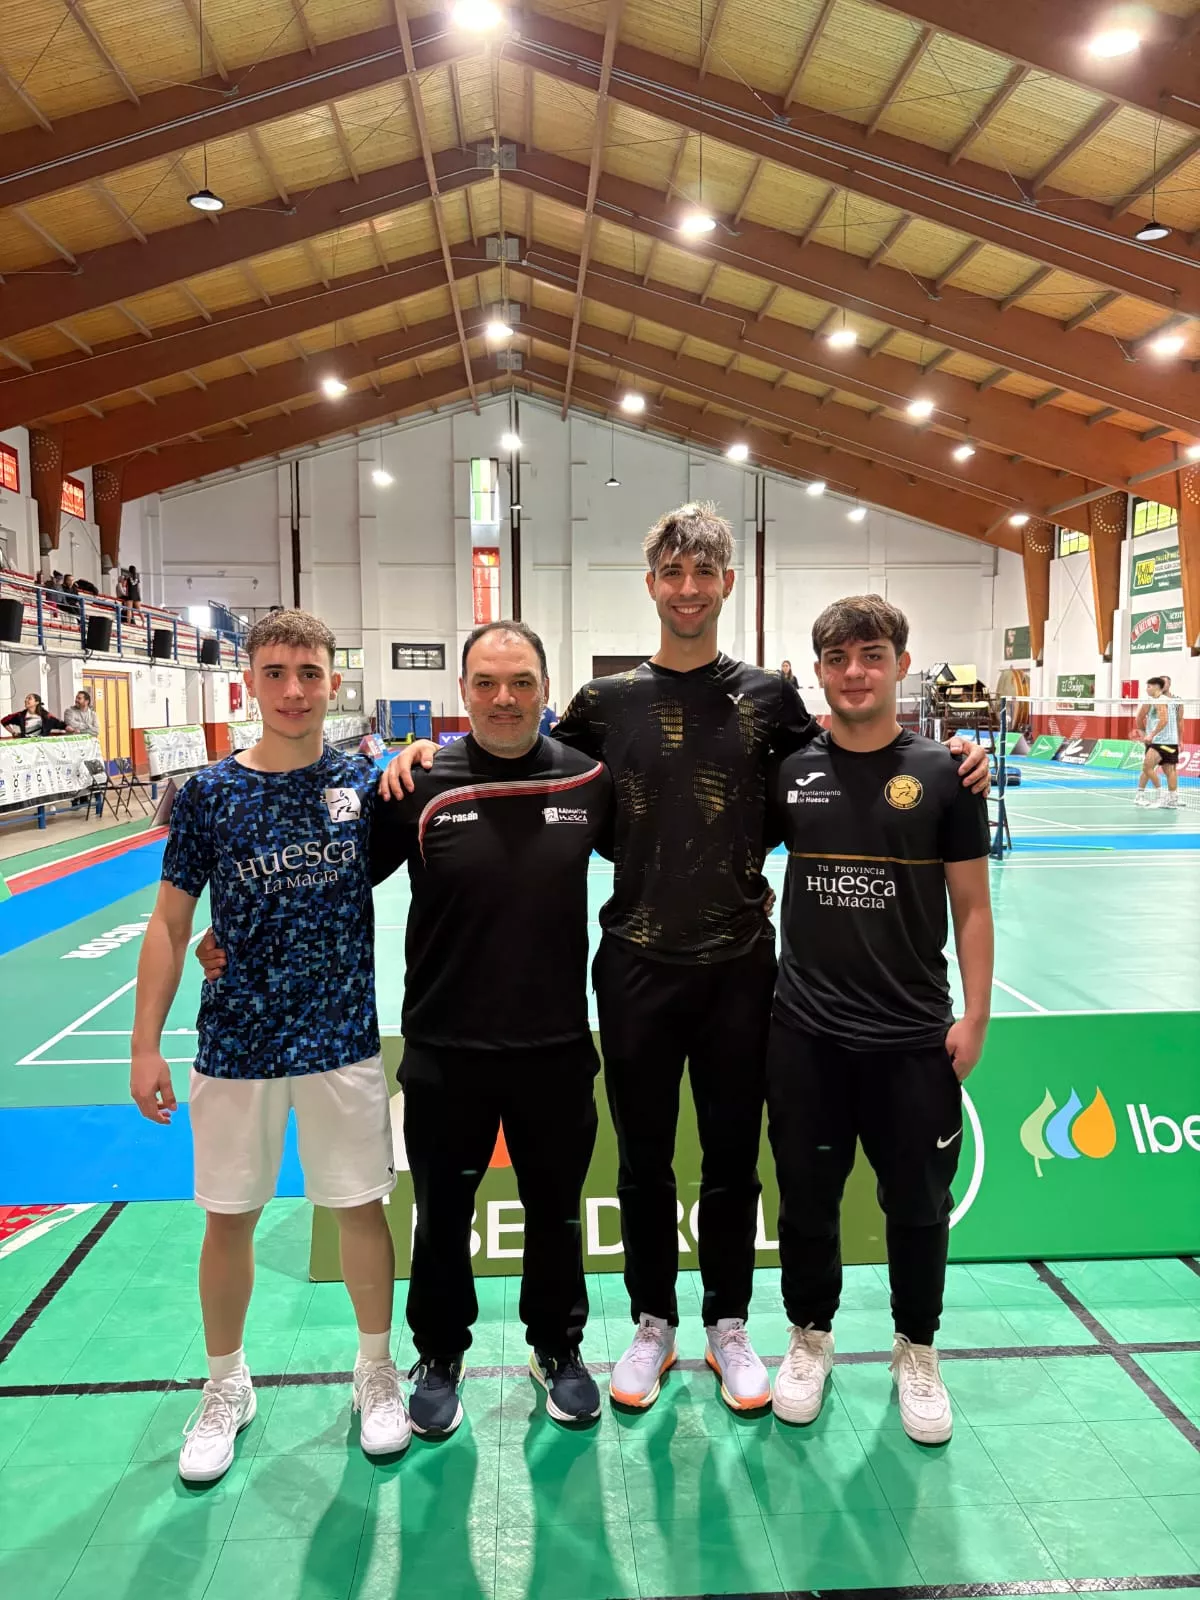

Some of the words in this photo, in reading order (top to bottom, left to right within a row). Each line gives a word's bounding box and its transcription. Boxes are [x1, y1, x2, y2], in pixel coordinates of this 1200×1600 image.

[452, 810, 479, 823] rasán
[235, 839, 357, 882] Huesca
[264, 878, 282, 894] La
[806, 875, 896, 897] Huesca
[819, 894, 833, 906] La
